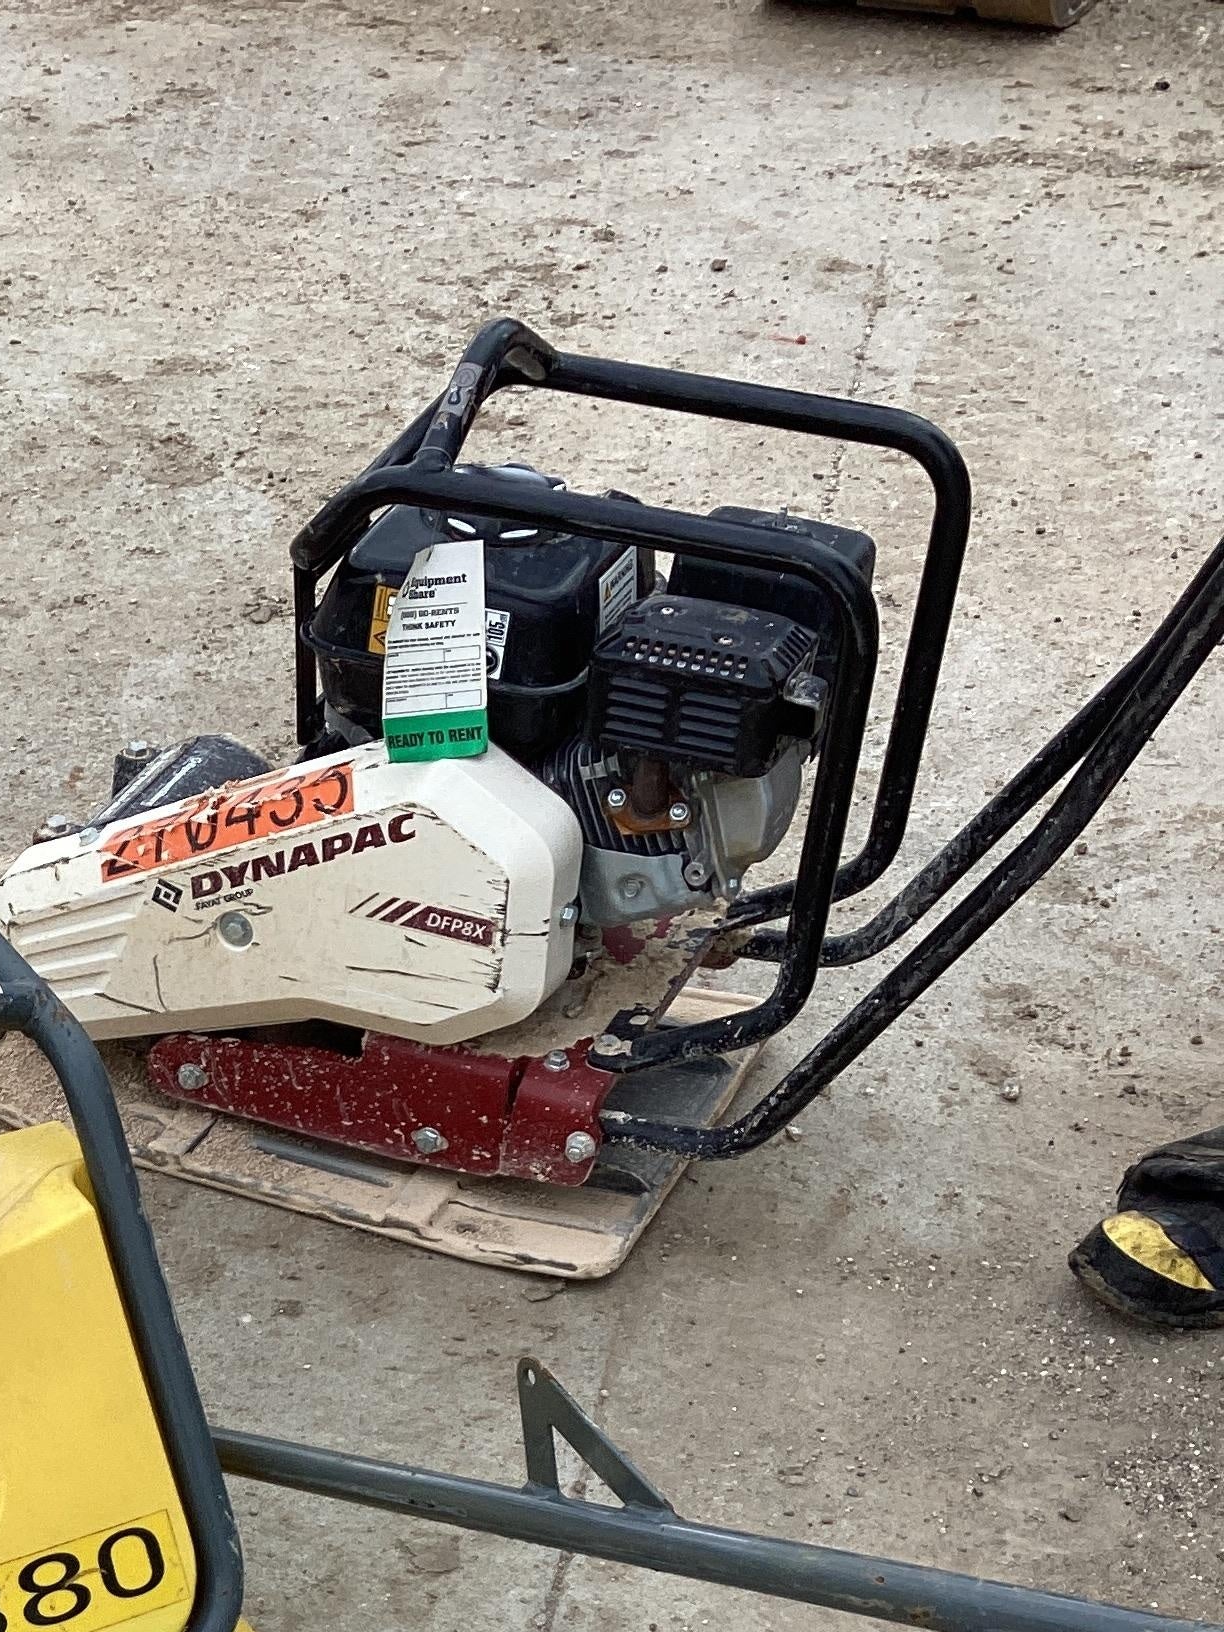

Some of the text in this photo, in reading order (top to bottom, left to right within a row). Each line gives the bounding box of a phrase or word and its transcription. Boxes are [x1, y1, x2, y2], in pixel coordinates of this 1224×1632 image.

[424, 620, 456, 630] SAFETY
[387, 726, 483, 749] READY TO RENT
[191, 812, 417, 900] DYNAPAC
[223, 888, 254, 904] GROUP
[426, 912, 487, 940] DFP8X
